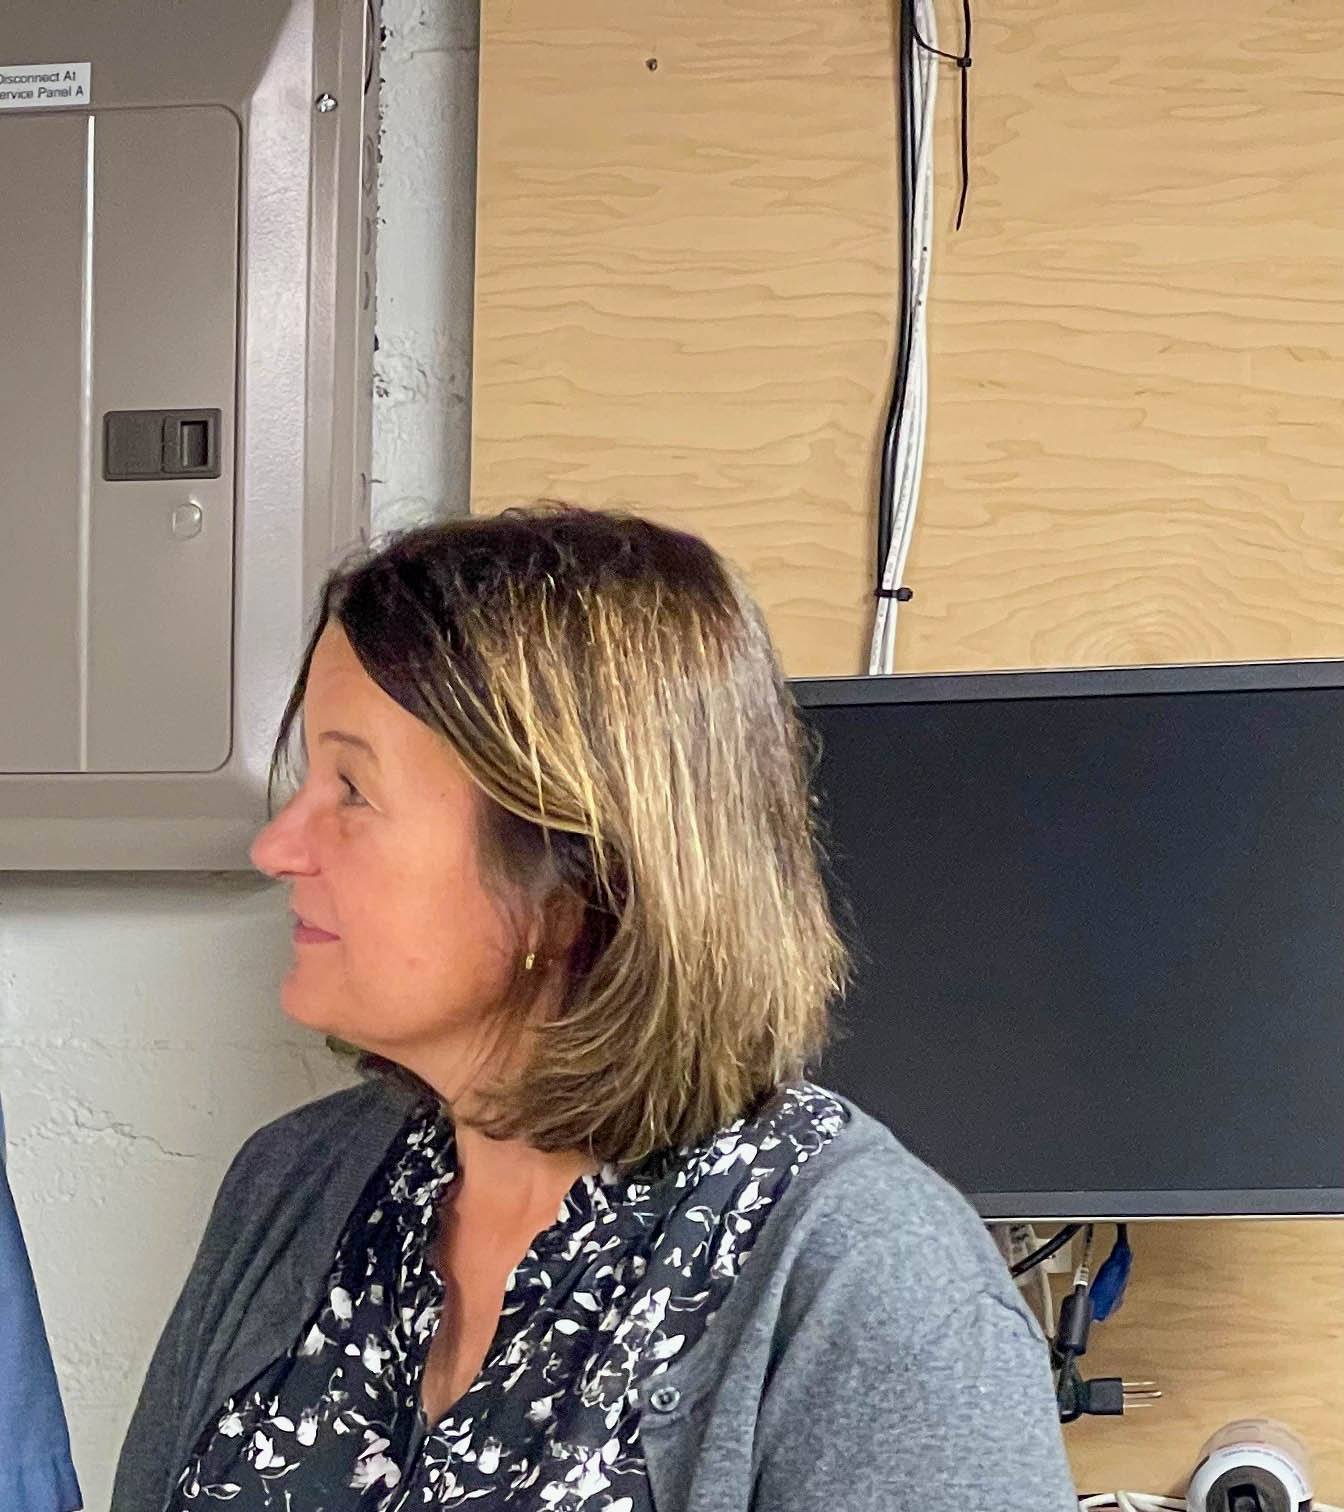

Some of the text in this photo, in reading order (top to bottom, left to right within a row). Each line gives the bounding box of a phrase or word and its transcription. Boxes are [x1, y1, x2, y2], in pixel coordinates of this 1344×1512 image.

[63, 71, 76, 82] At
[38, 86, 72, 99] Panel
[75, 85, 84, 97] A
